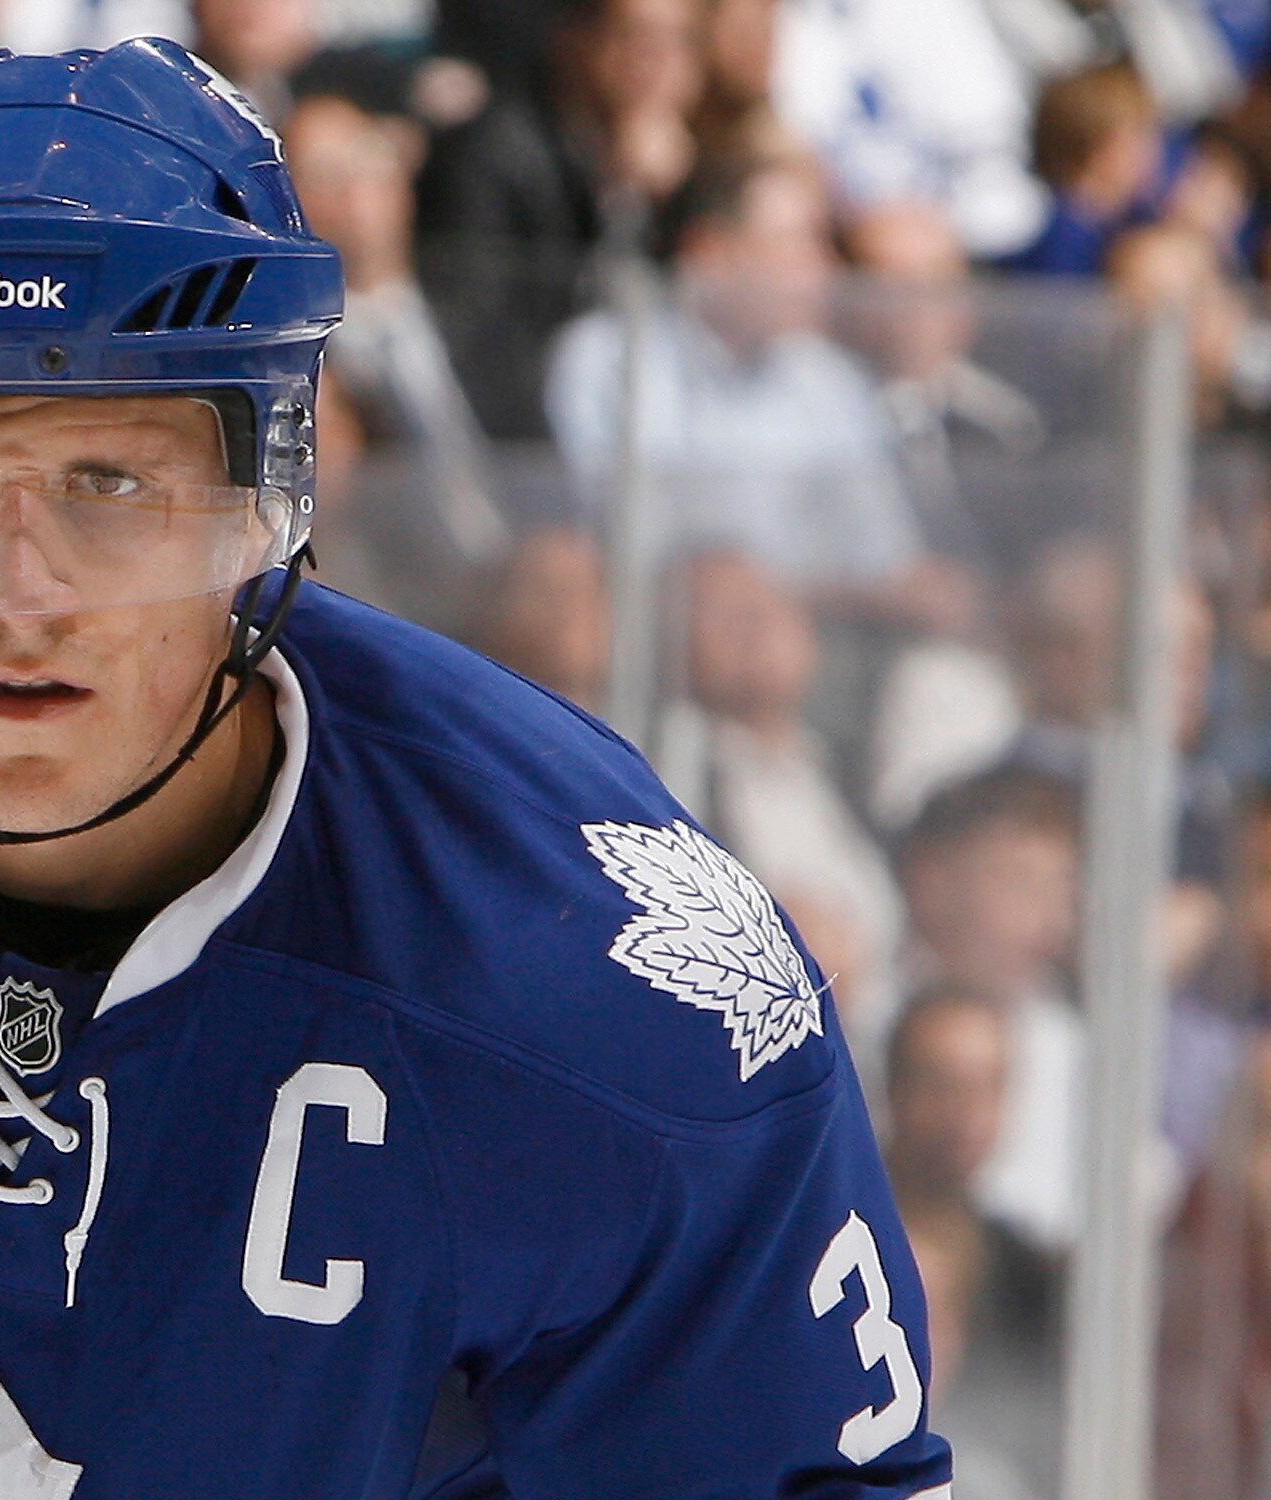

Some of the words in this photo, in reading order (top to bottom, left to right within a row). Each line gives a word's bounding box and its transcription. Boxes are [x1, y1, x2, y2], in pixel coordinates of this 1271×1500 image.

[5, 1011, 47, 1050] NHL
[239, 1061, 388, 1326] C
[808, 1208, 924, 1467] 3
